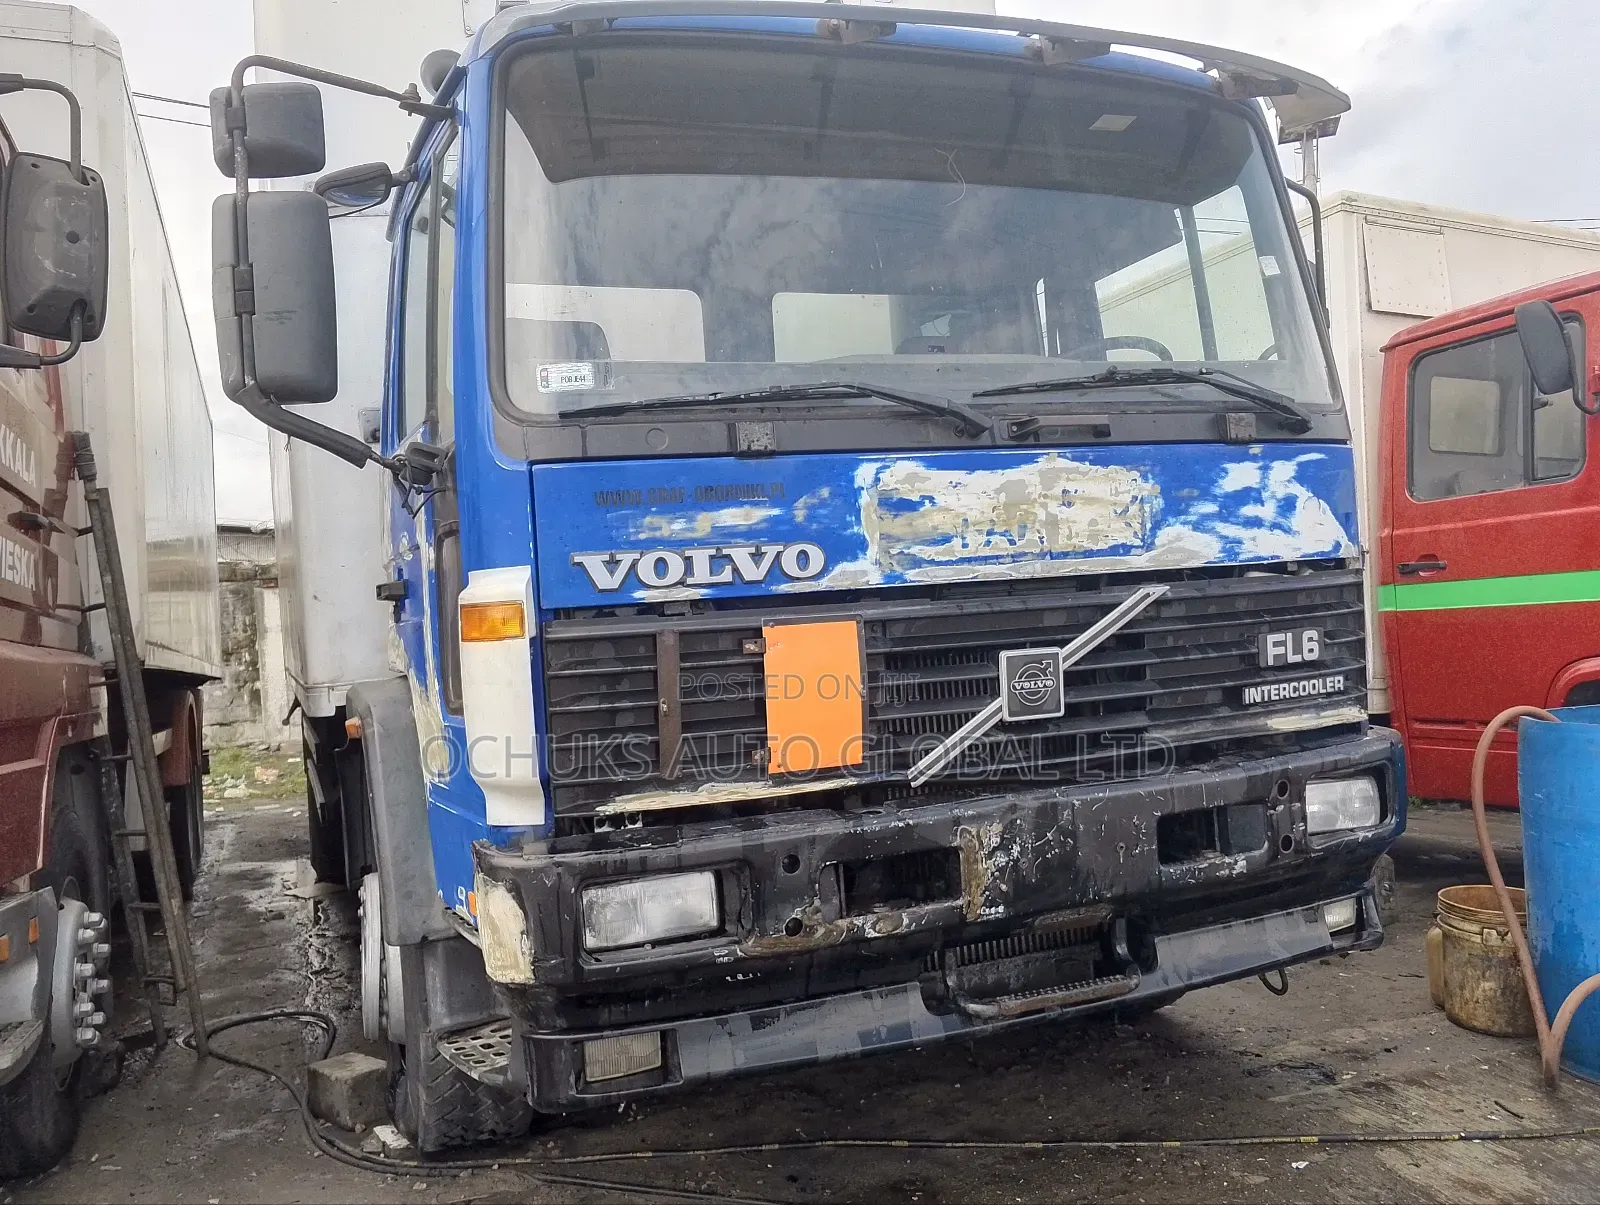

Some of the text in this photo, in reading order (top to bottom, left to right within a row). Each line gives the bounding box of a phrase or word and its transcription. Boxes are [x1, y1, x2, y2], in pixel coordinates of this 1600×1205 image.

[0, 536, 36, 592] IESKA
[571, 542, 826, 593] VOLVO
[1266, 629, 1320, 666] FL6
[1012, 679, 1055, 690] VOLVO
[1243, 676, 1344, 705] INTERCOOLER
